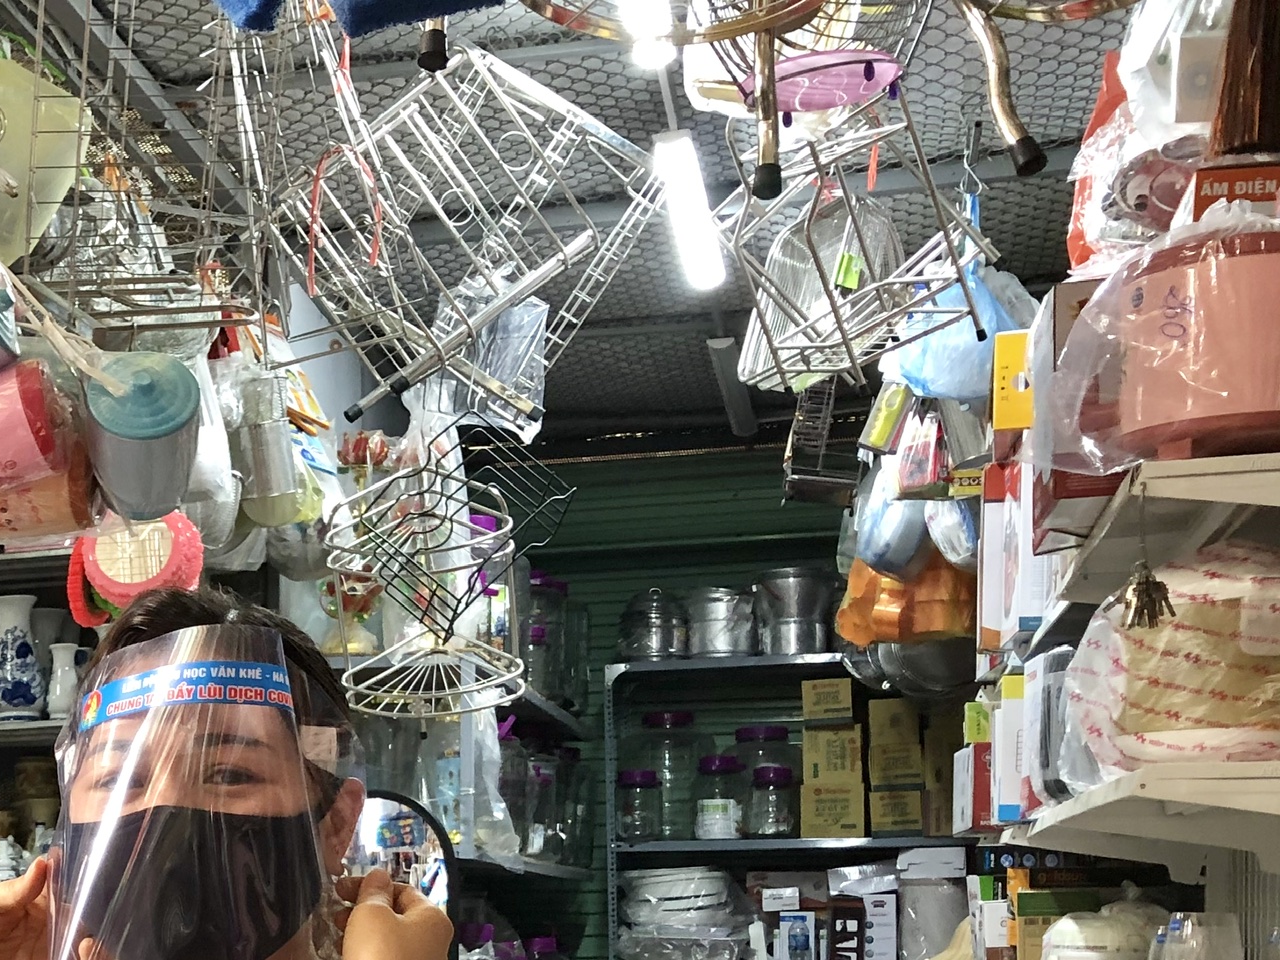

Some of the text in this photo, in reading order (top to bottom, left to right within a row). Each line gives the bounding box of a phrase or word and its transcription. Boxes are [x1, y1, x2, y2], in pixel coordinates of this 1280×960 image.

[1200, 177, 1277, 196] ẤM ĐIỆN
[183, 667, 206, 681] HỌC
[210, 665, 236, 678] VĂN
[239, 666, 262, 680] KHÊ
[106, 696, 143, 716] CHUNG
[198, 684, 224, 699] LÙI
[227, 686, 264, 703] DỊCH
